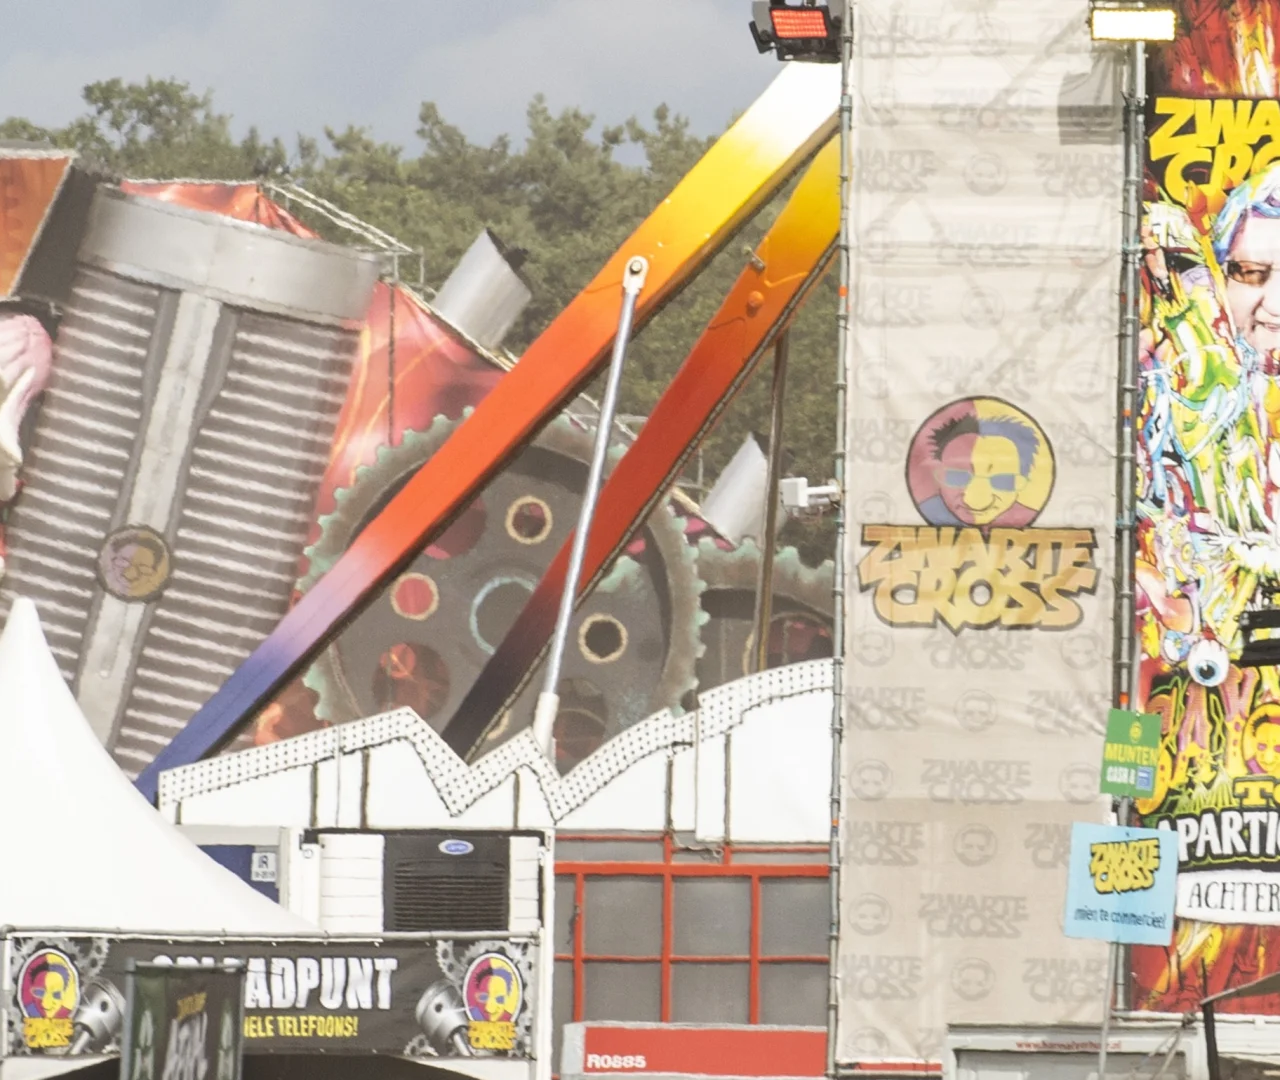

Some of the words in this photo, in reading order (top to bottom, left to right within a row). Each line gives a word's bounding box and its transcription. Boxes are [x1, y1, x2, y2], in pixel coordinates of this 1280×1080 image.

[857, 525, 1100, 594] ZWARTE
[873, 565, 1084, 636] CROSS
[277, 1015, 359, 1037] TELEFOONS!
